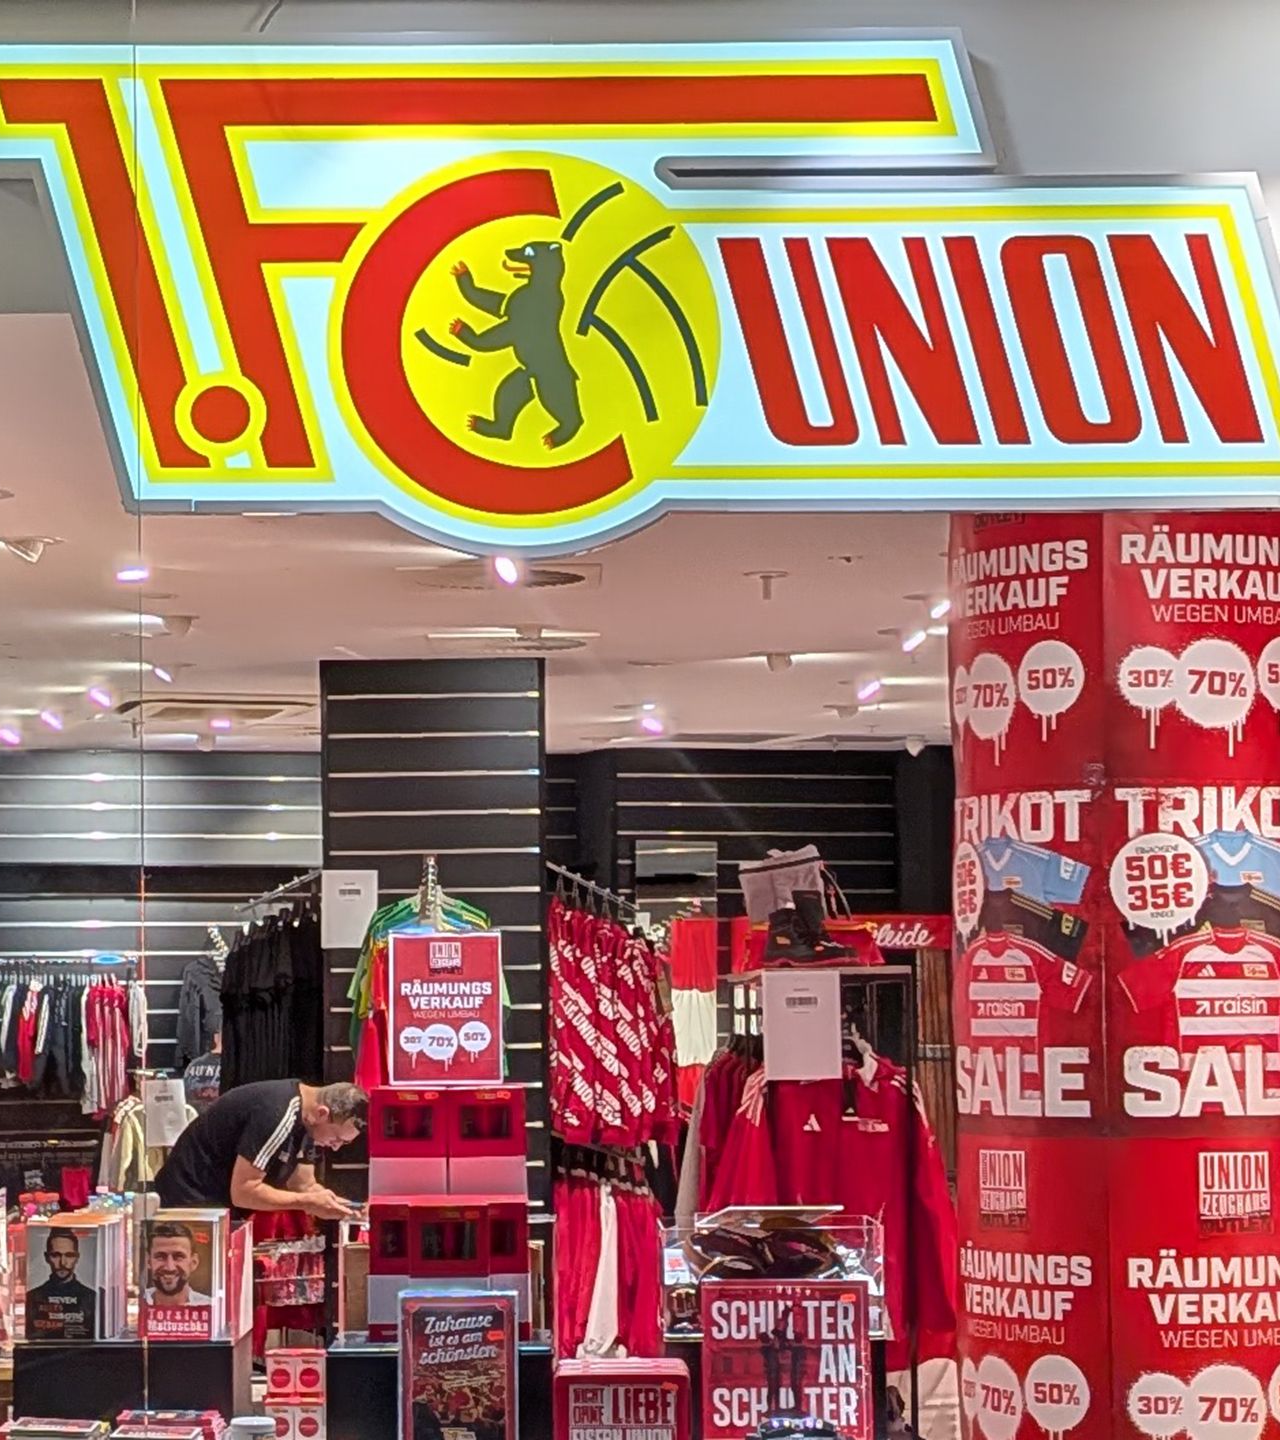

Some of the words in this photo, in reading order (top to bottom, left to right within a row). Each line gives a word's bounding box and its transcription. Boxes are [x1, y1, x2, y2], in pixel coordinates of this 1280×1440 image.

[717, 233, 1264, 447] UNION
[997, 611, 1060, 636] UMBAU
[1151, 604, 1230, 625] WEGEN
[1026, 667, 1075, 691] 50%
[1127, 668, 1175, 689] 30%
[1187, 668, 1248, 697] 70%
[972, 682, 1010, 709] 70%
[1125, 853, 1193, 882] 50€
[1127, 882, 1195, 912] 35€
[400, 978, 493, 996] RÄUMUNGS
[408, 995, 485, 1010] VERKAUF
[1213, 994, 1268, 1015] raisin
[427, 1035, 455, 1048] 70%
[463, 1031, 487, 1042] 50%
[957, 1045, 1092, 1119] SALE
[1203, 1154, 1266, 1190] UNION
[1202, 1192, 1270, 1216] ZEUGHAUS
[964, 1282, 1075, 1322] VERKAUF
[423, 1315, 494, 1335] Zuhause
[1004, 1323, 1066, 1346] UMBAU
[428, 1333, 445, 1348] ist
[446, 1334, 460, 1346] es
[462, 1331, 483, 1344] am
[1161, 1329, 1239, 1349] WEGEN
[419, 1344, 499, 1365] schönsten
[817, 1343, 857, 1384] AN
[611, 1387, 673, 1424] LIEBE
[980, 1384, 1018, 1417] 70%
[1033, 1382, 1081, 1407] 50%
[1137, 1395, 1184, 1417] 30%
[712, 1386, 859, 1428] SCHTER
[1198, 1396, 1259, 1425] 70%
